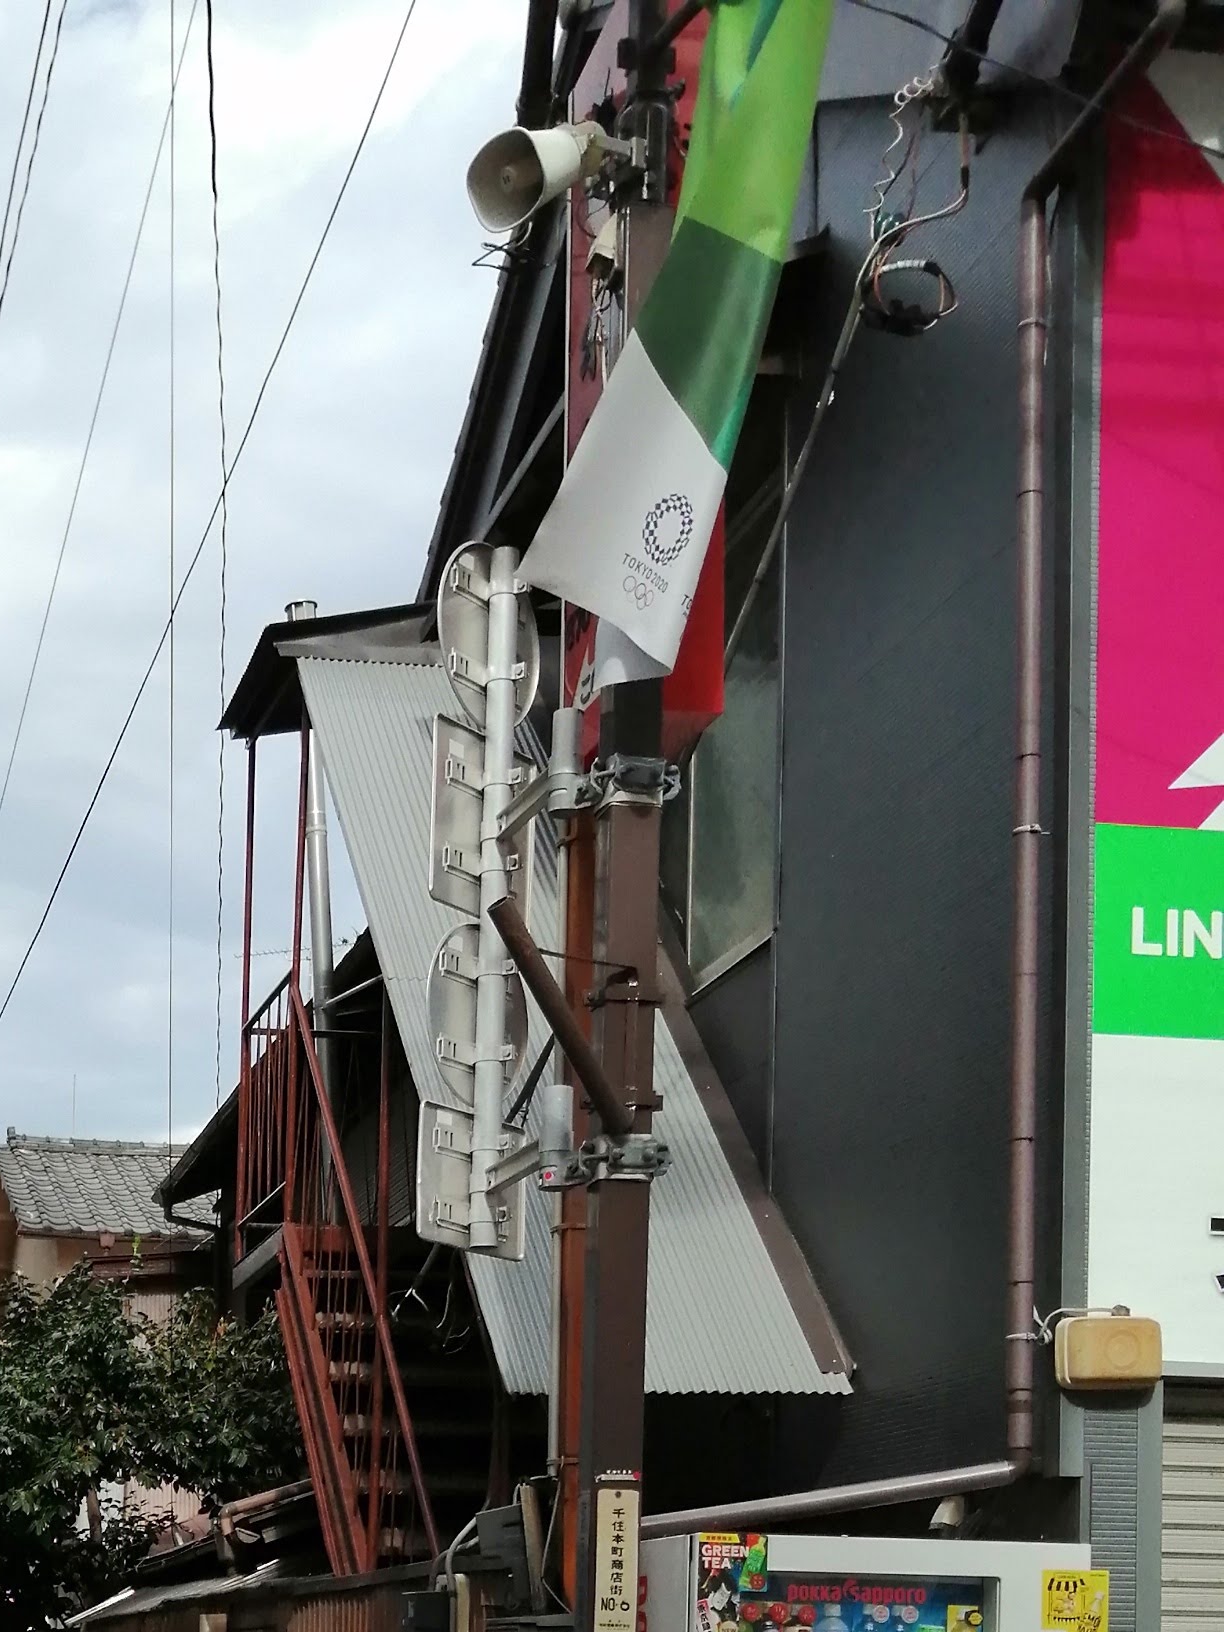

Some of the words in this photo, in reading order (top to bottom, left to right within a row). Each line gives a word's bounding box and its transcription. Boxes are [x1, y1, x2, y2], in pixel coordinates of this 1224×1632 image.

[622, 553, 652, 580] TOKYO
[650, 572, 669, 593] 2020
[1131, 906, 1223, 960] LIN
[610, 1508, 625, 1597] 千住本町商店街
[701, 1544, 749, 1557] GREEN
[701, 1557, 731, 1569] TEA
